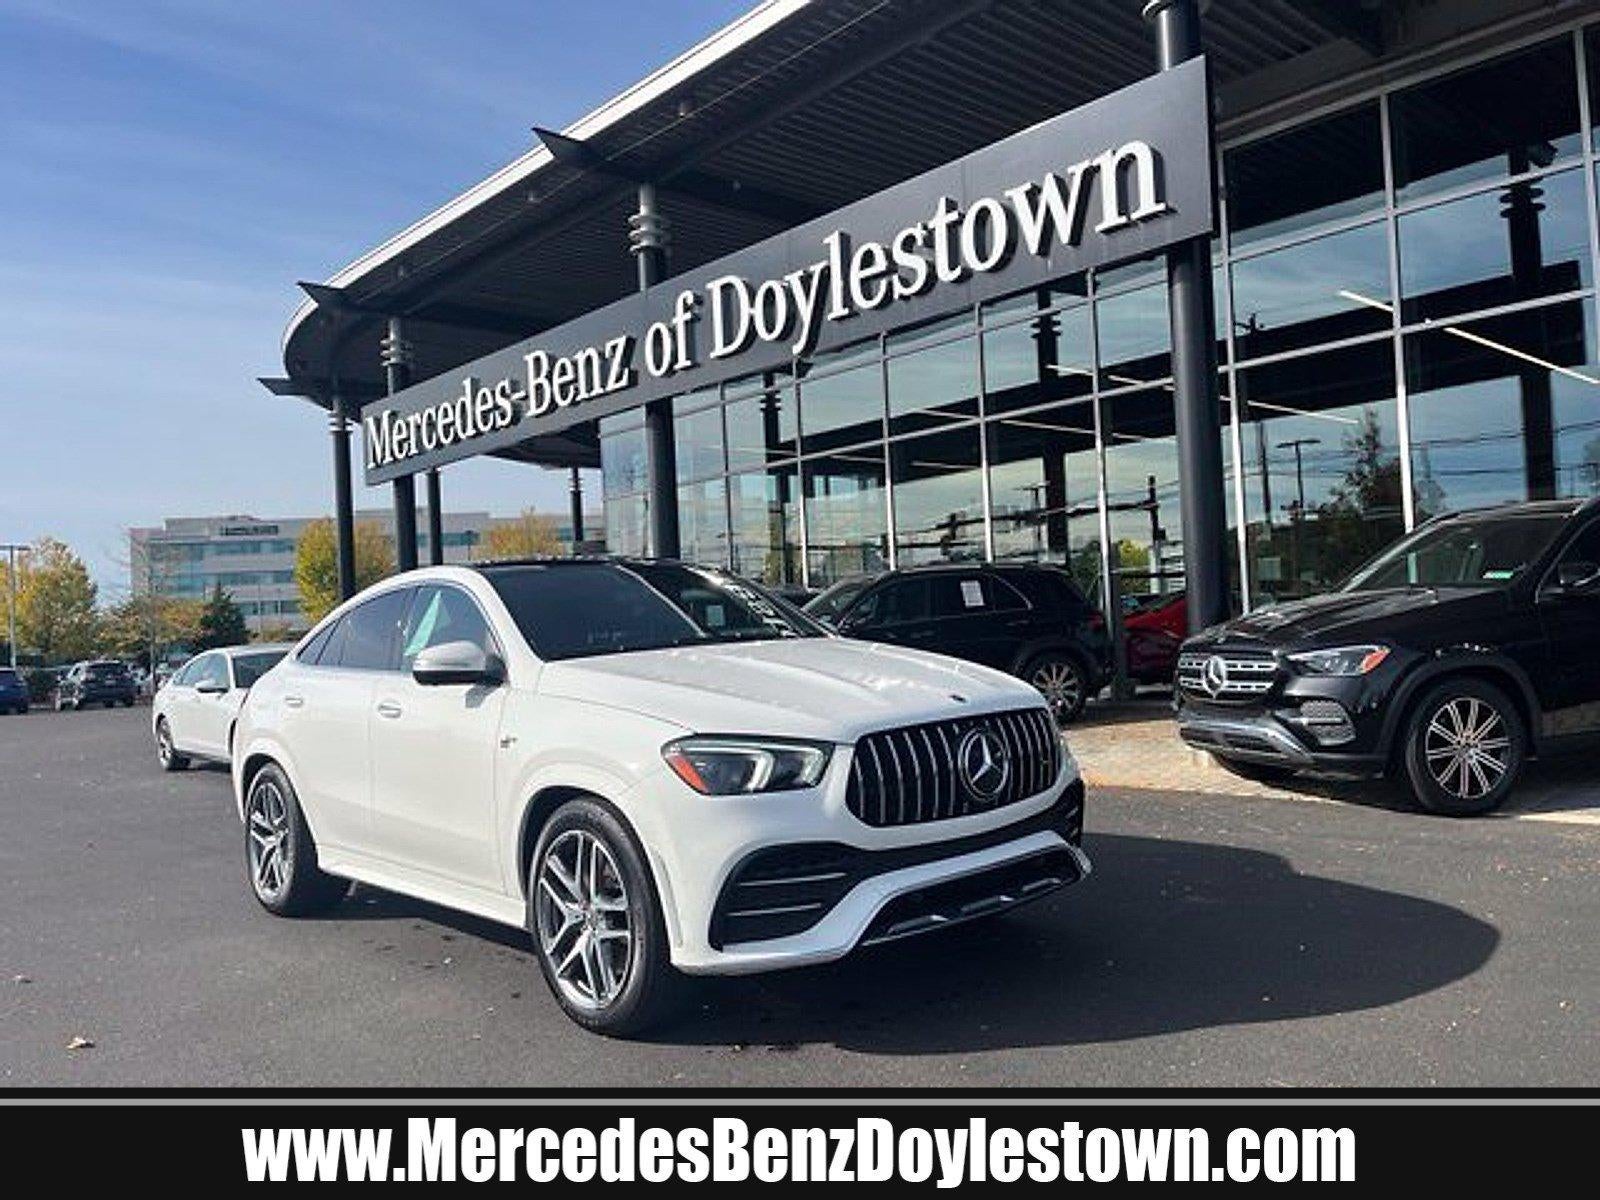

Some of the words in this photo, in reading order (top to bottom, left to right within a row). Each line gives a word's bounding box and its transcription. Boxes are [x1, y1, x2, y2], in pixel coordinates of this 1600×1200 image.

[365, 335, 631, 468] Mercedes-Benz
[645, 290, 696, 377] of
[706, 140, 1167, 355] Doylestown
